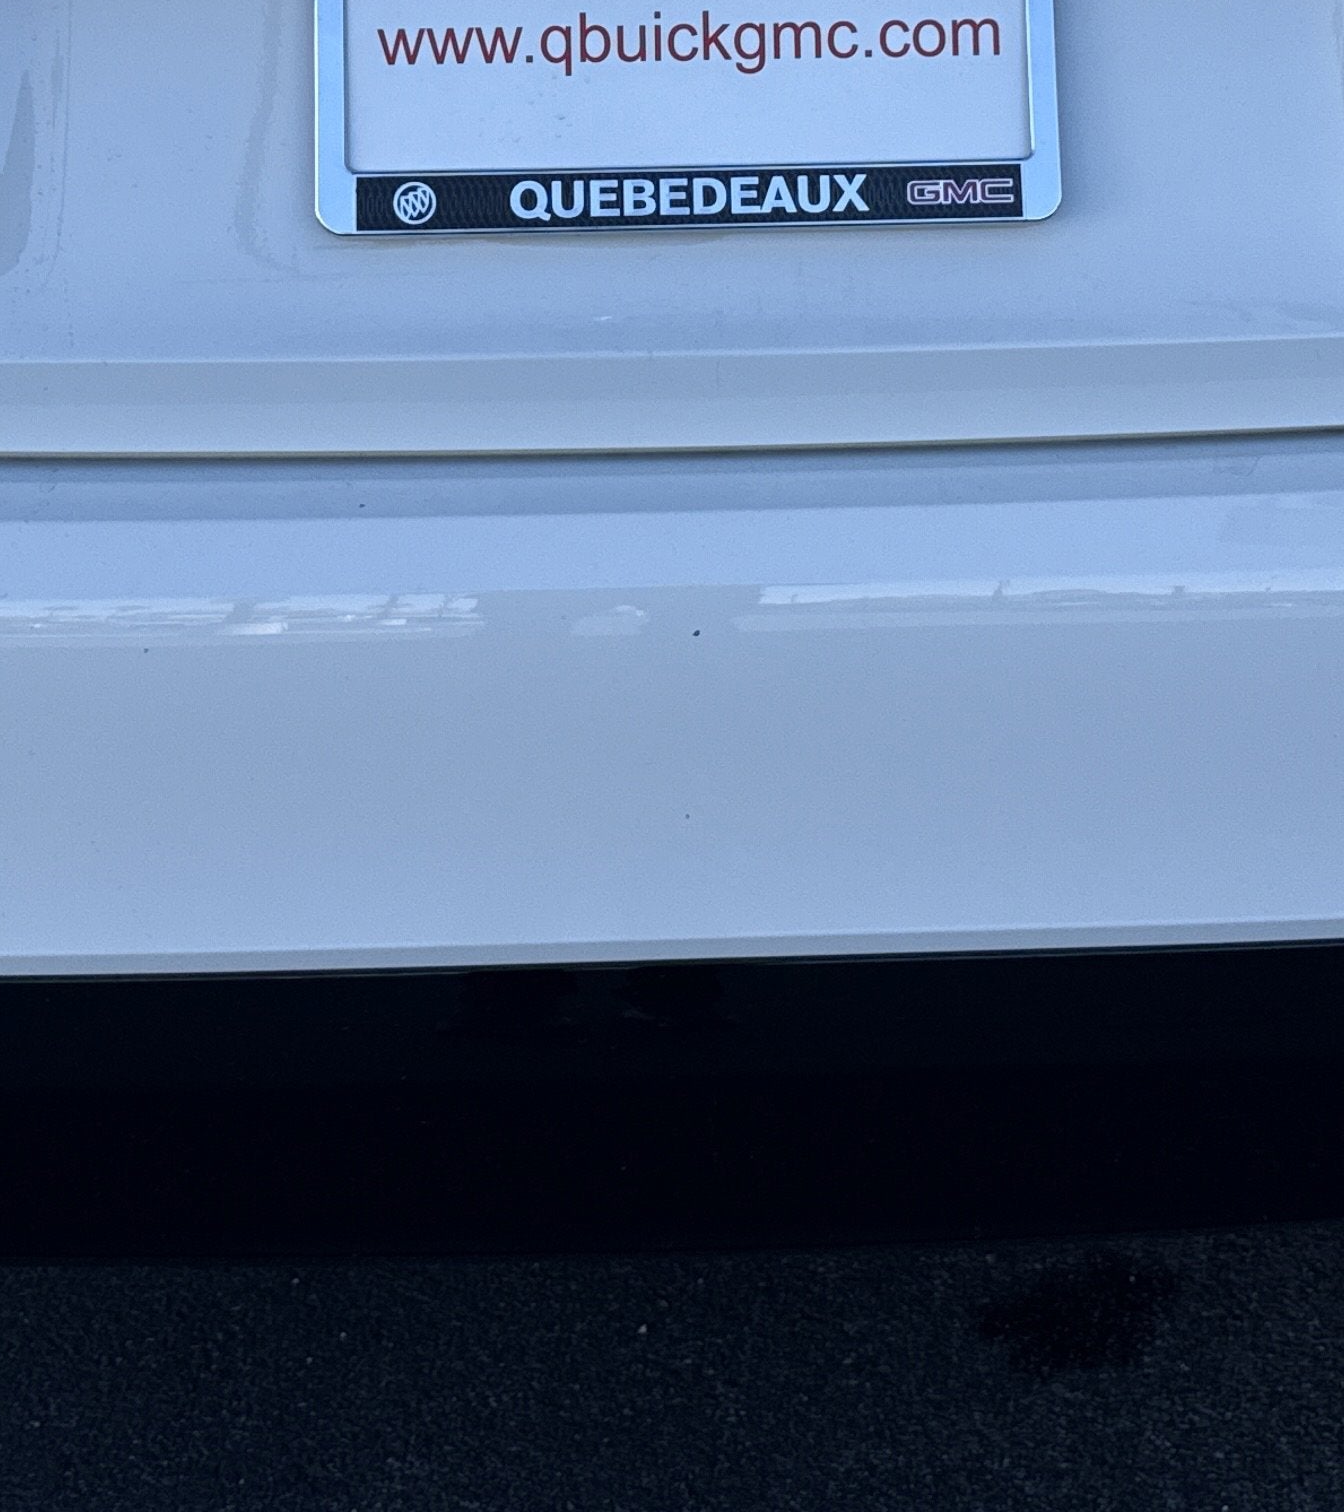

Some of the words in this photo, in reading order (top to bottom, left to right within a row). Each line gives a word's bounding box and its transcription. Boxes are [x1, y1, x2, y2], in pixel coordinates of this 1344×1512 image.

[377, 10, 1001, 76] www.qbuickgmc.com
[509, 174, 870, 221] QUEBEDEAUX
[907, 178, 1015, 205] GMC
